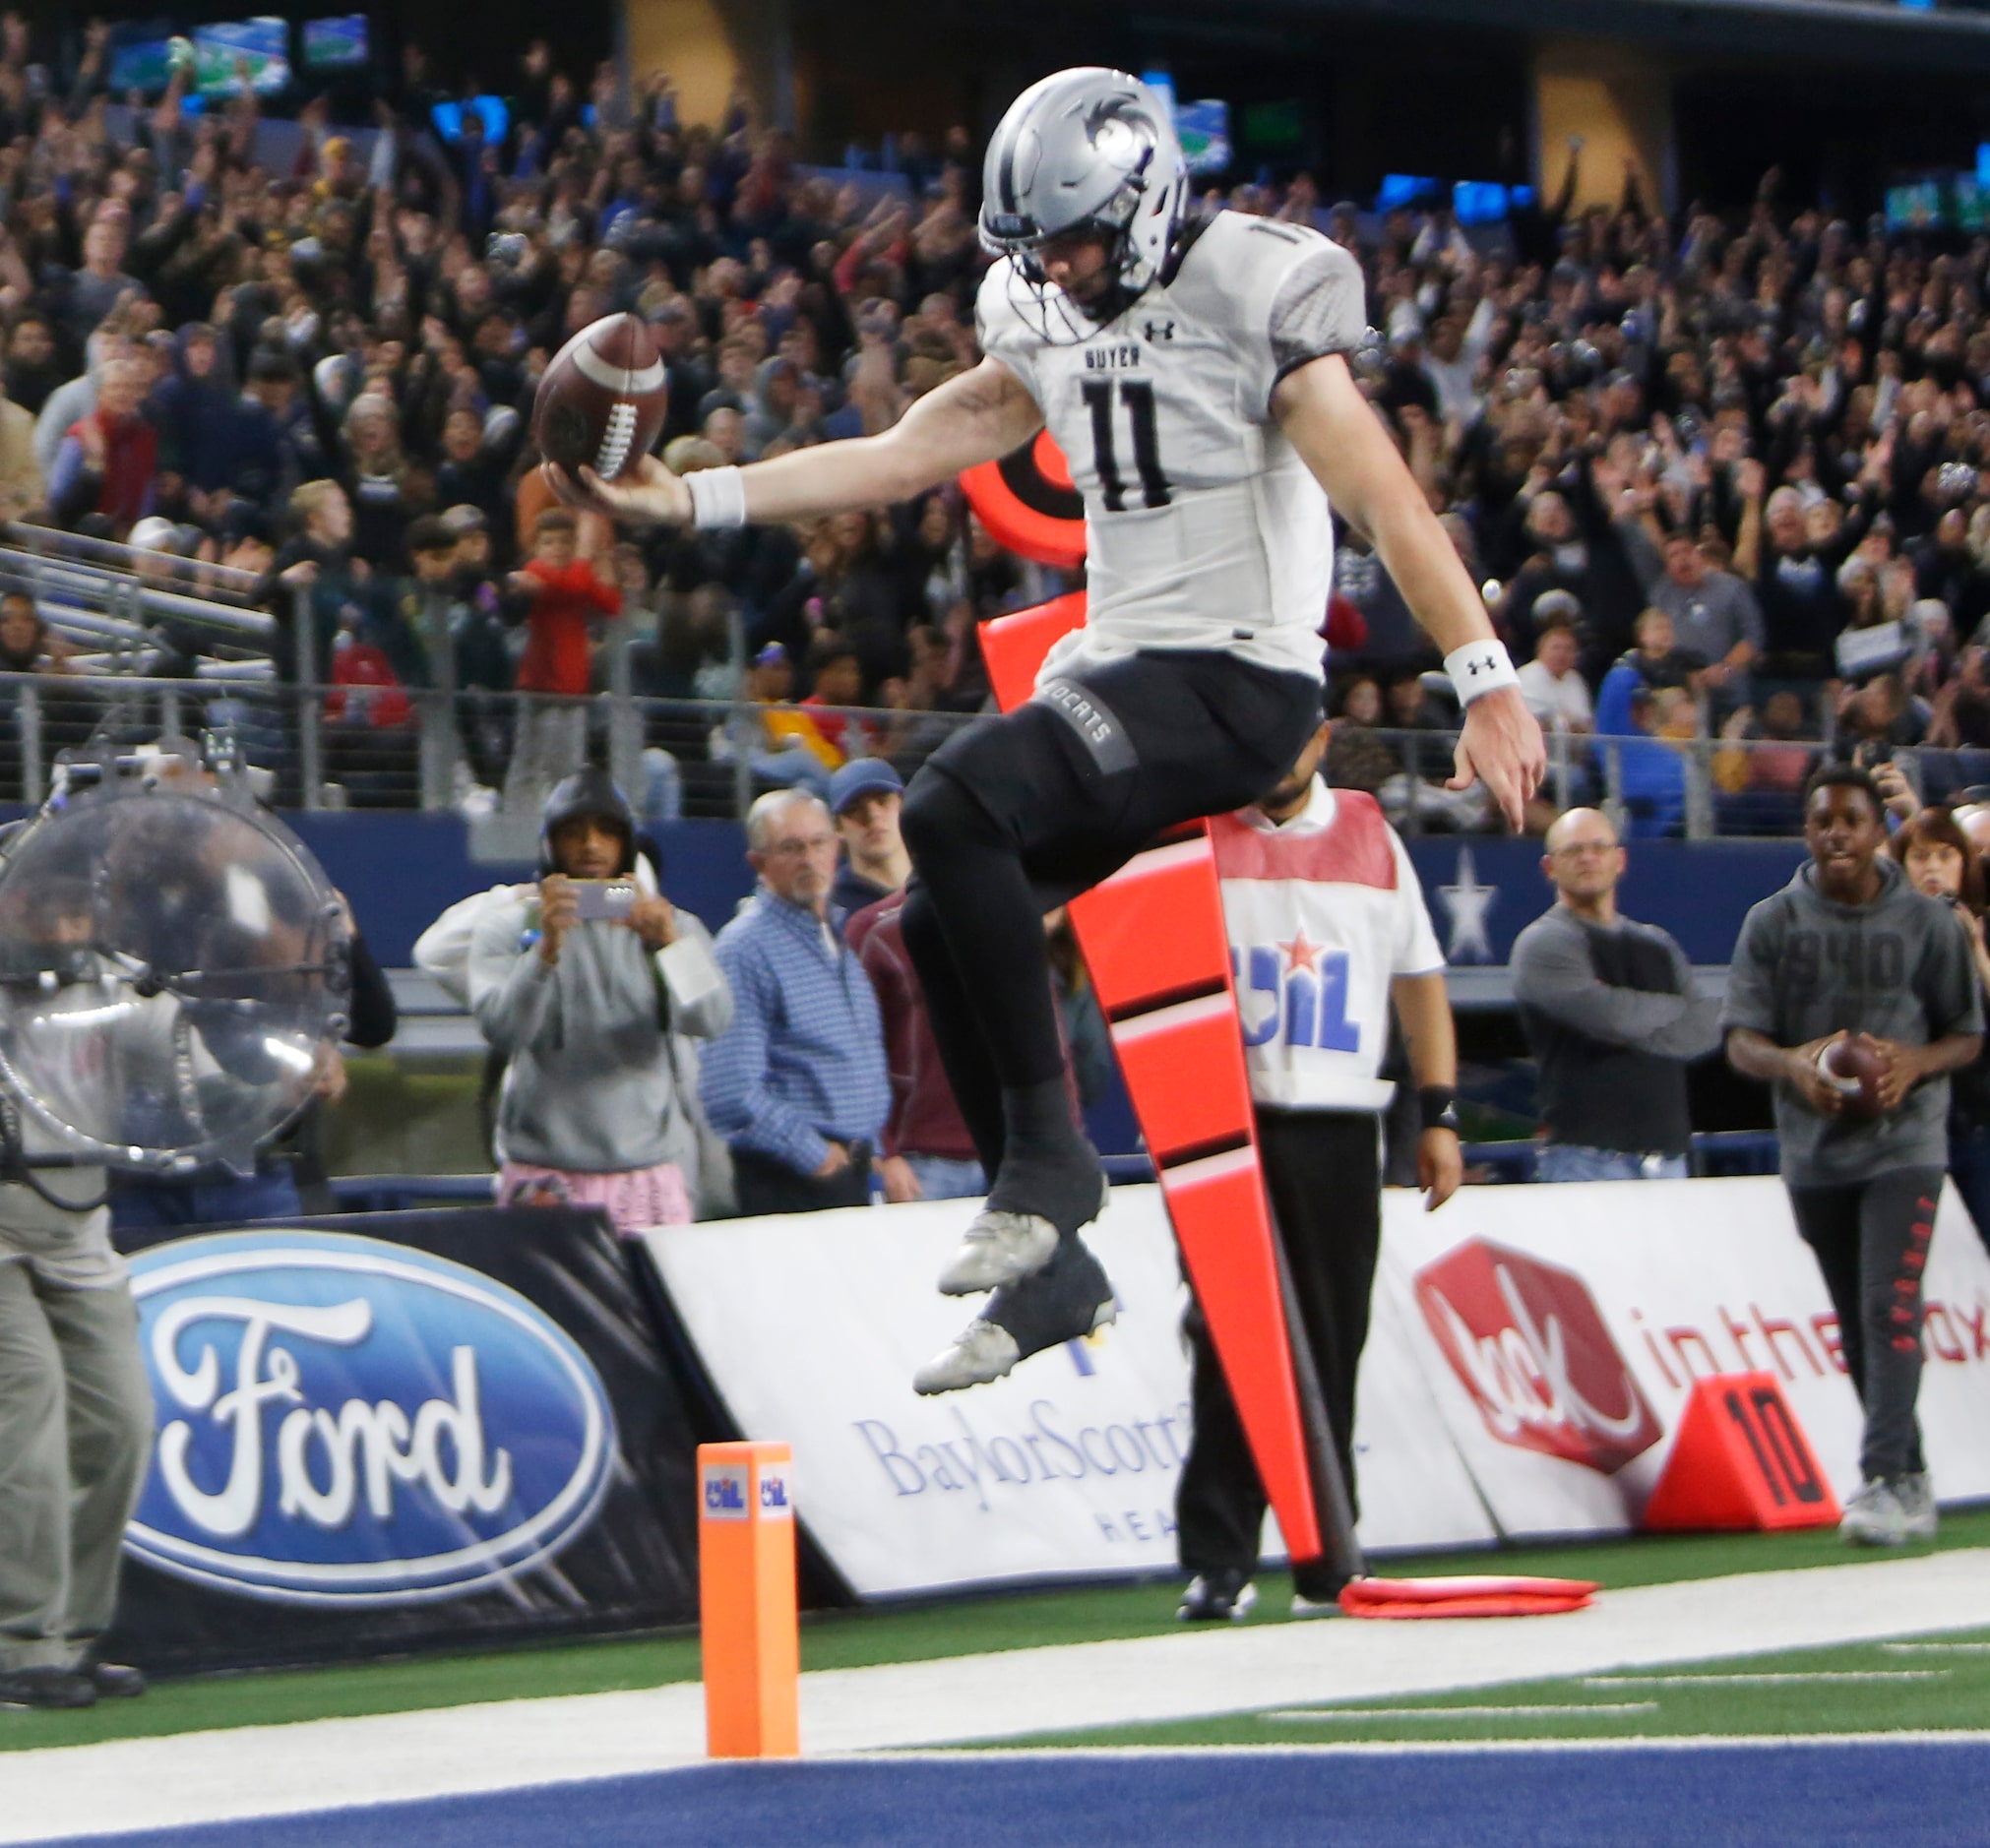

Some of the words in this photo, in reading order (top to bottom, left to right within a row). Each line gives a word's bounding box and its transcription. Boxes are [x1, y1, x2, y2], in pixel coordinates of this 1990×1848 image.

[1081, 378, 1175, 512] 11
[1785, 930, 1904, 989] 940
[1629, 1304, 1723, 1389] in
[1717, 1301, 1853, 1380] the
[1919, 1297, 1990, 1364] ox
[152, 1295, 514, 1537] Ford
[1725, 1386, 1824, 1506] 10
[1093, 1509, 1179, 1543] HEA
